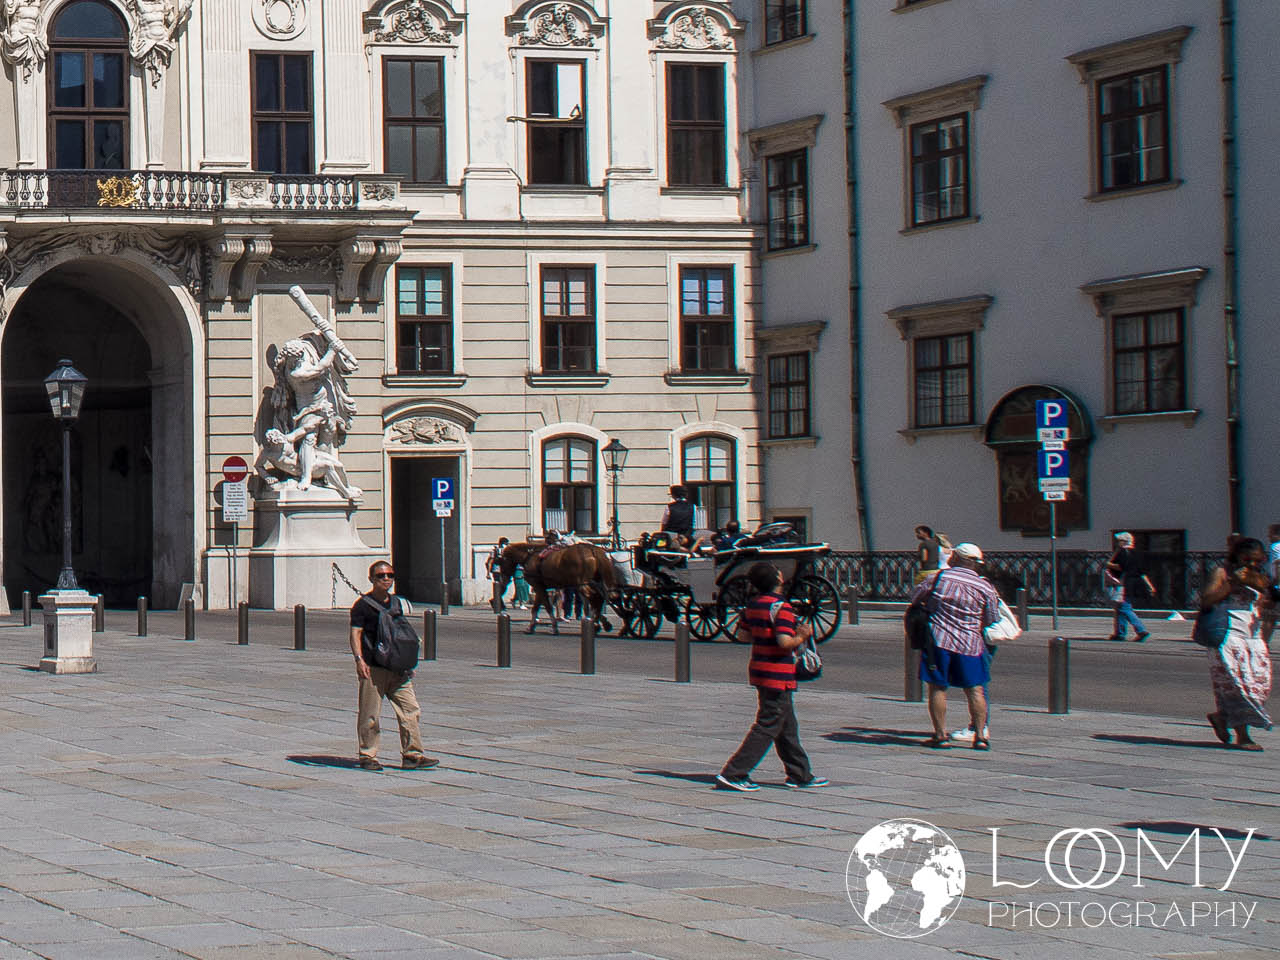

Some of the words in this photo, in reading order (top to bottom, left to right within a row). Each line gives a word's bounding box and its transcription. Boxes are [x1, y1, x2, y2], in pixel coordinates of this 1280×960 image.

[1043, 402, 1063, 426] P
[1045, 452, 1064, 476] P
[437, 480, 449, 498] P
